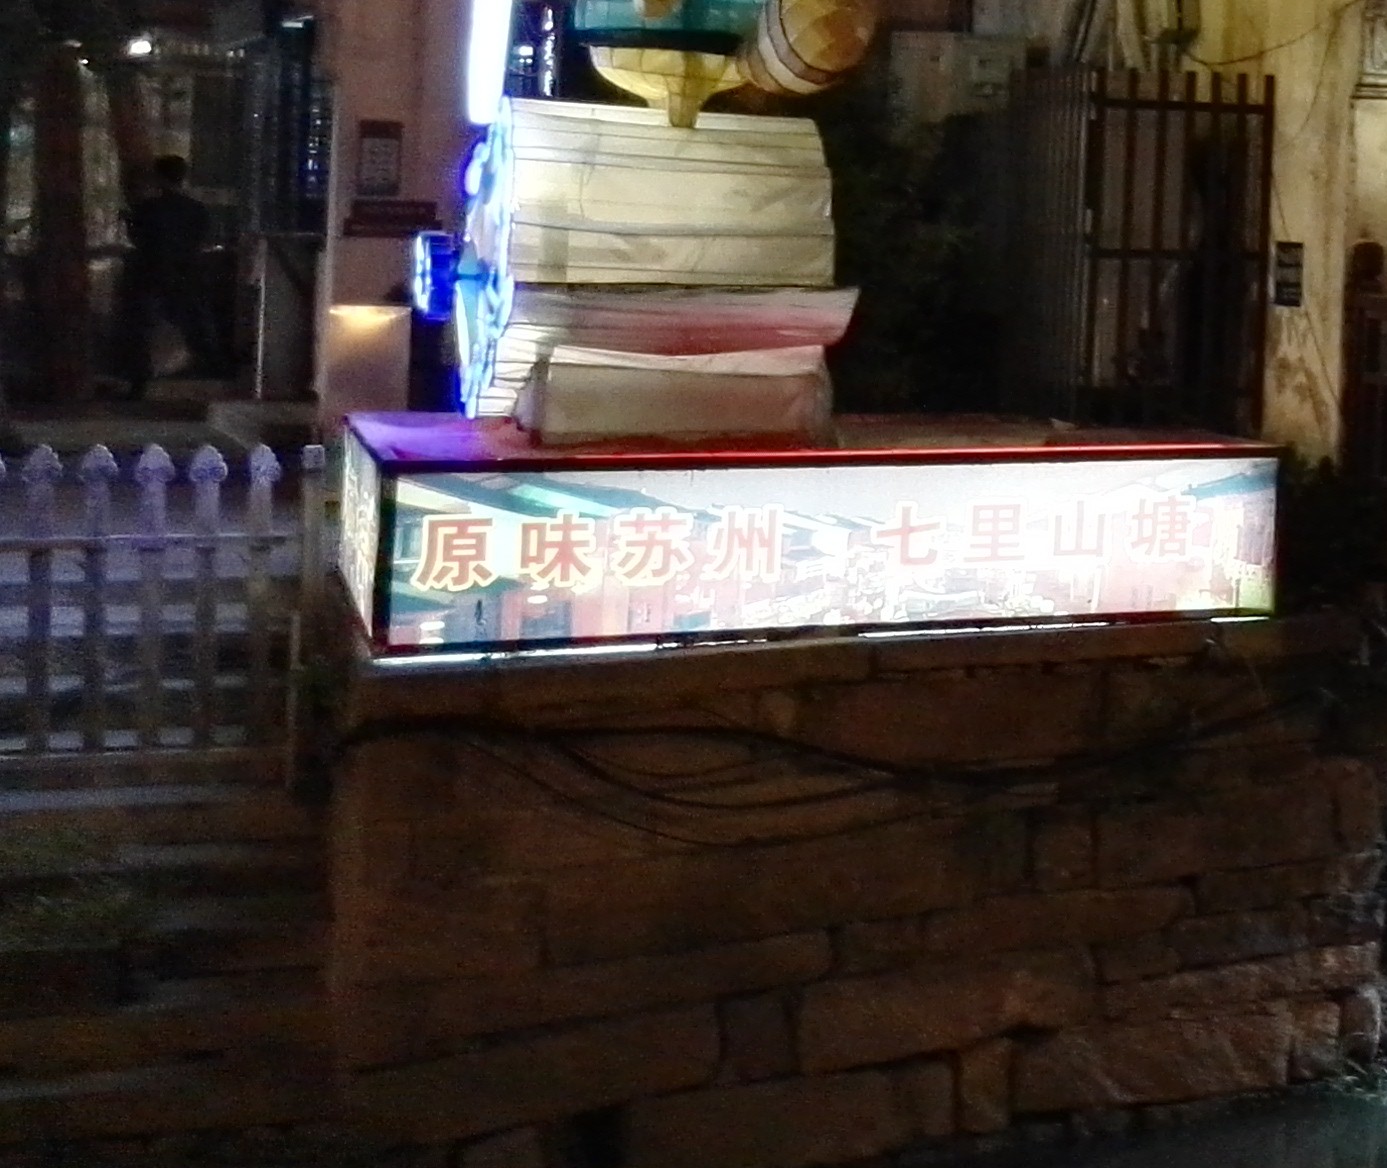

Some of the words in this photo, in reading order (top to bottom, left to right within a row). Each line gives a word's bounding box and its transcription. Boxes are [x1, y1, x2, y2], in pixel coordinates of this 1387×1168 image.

[413, 506, 781, 589] 原味苏州
[875, 495, 1193, 566] 七里山塘
